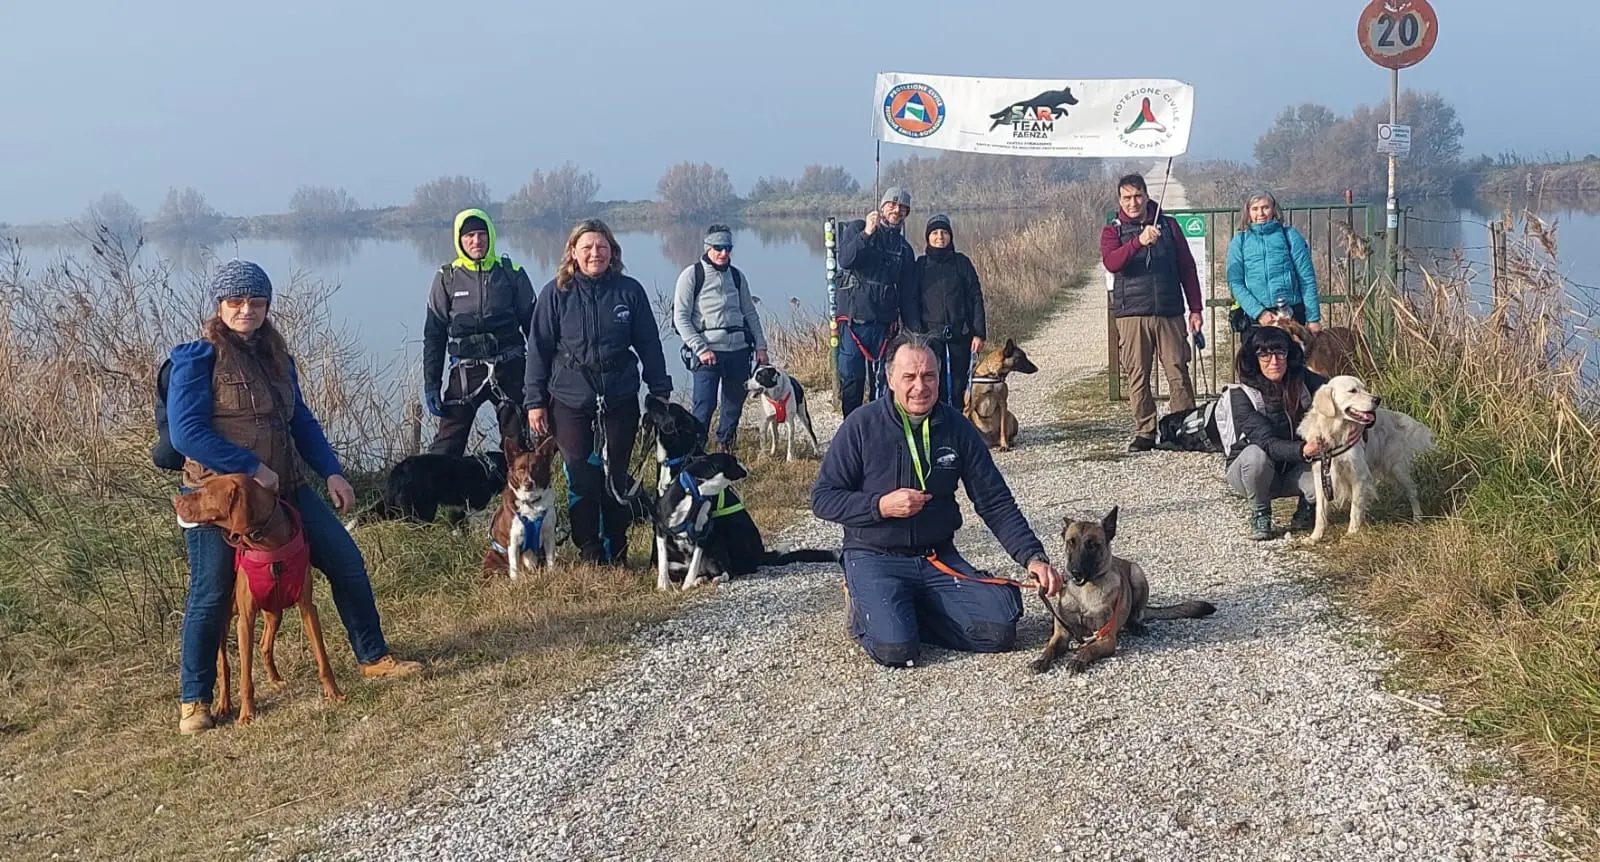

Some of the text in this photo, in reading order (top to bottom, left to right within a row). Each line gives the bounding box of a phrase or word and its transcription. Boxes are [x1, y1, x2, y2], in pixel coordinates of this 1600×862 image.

[1378, 13, 1418, 47] 20
[890, 84, 943, 107] PROTEZIONE CIVILE
[1011, 105, 1053, 121] SAR
[1113, 87, 1180, 123] PROTEZIONE CIVILE
[1011, 121, 1054, 132] TEAM
[1013, 131, 1048, 139] FAENZA
[1117, 132, 1173, 149] NAZIONALE
